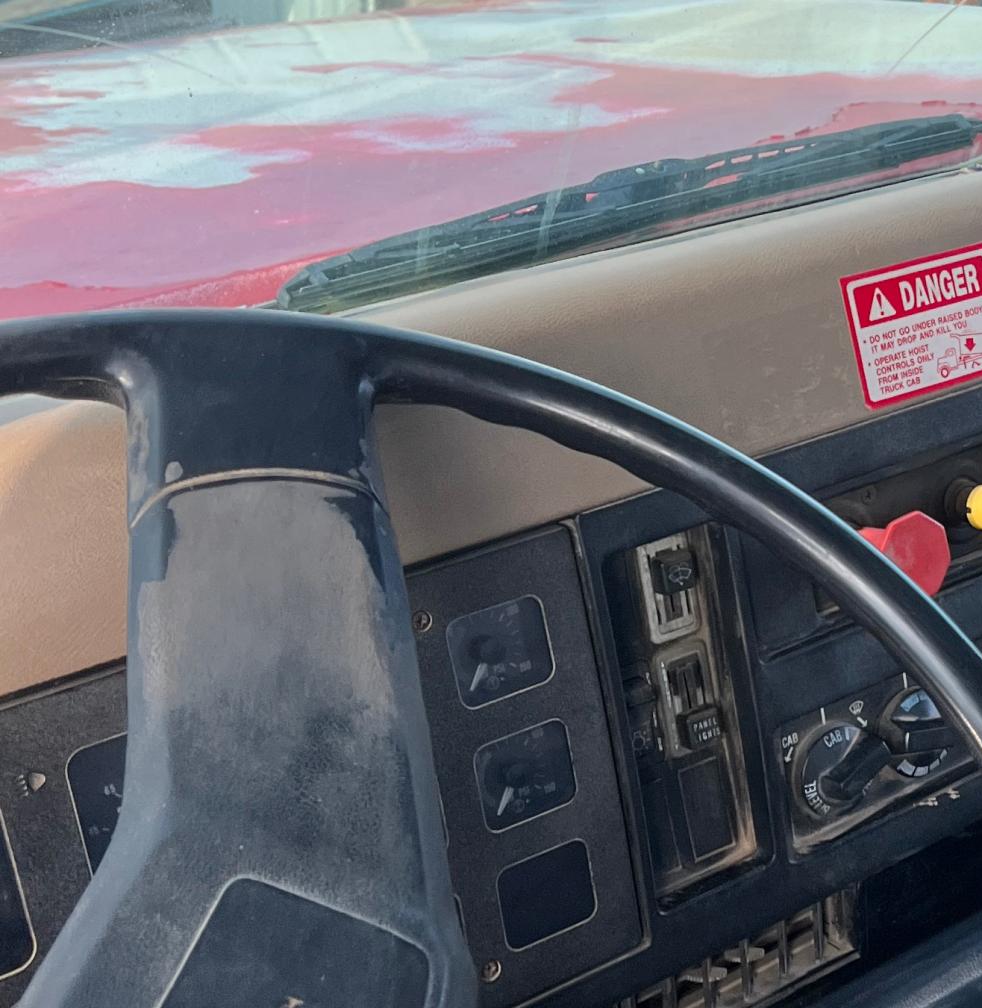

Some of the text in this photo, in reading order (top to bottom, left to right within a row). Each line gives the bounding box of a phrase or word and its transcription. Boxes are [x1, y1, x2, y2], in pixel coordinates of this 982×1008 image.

[898, 263, 980, 311] DANGER
[869, 306, 982, 344] DO NOT GO UNDER RAISED BODY
[881, 342, 895, 351] MAY
[897, 335, 917, 346] DROP
[919, 330, 934, 339] AND
[936, 325, 951, 335] KILL
[953, 321, 967, 330] YOU
[874, 345, 929, 366] OPERATE HOIST
[876, 353, 935, 375] CONTROLS ONLY
[878, 367, 924, 385] FROM INSIDE
[880, 377, 921, 394] TRUCK CAB
[693, 717, 718, 732] PANEL
[698, 727, 720, 742] IGHTS
[782, 732, 798, 748] CAB
[824, 730, 842, 748] CAB
